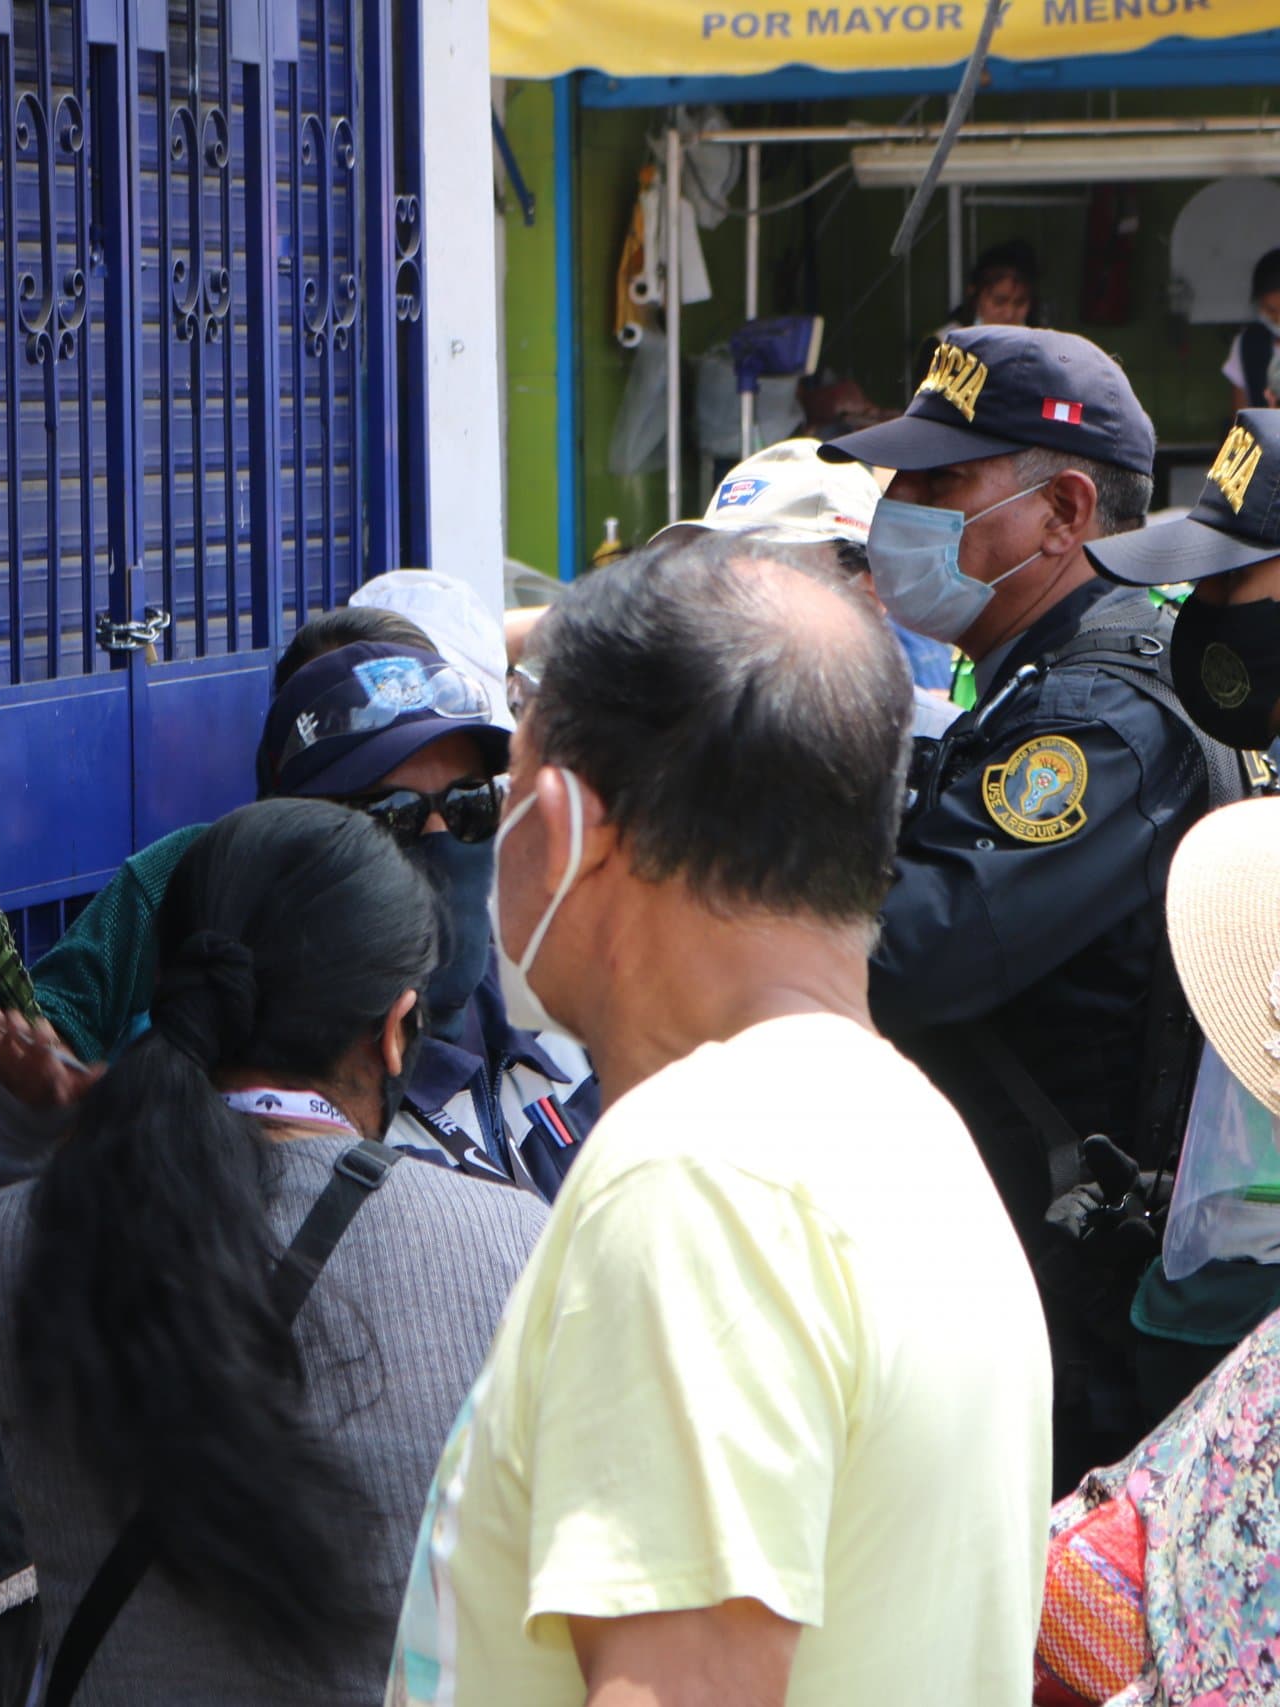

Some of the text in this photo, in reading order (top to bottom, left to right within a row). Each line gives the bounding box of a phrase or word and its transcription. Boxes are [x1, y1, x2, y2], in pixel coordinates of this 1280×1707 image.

[701, 12, 792, 40] POR
[807, 4, 963, 36] MAYOR
[988, 781, 1072, 838] USE AREQUIPA
